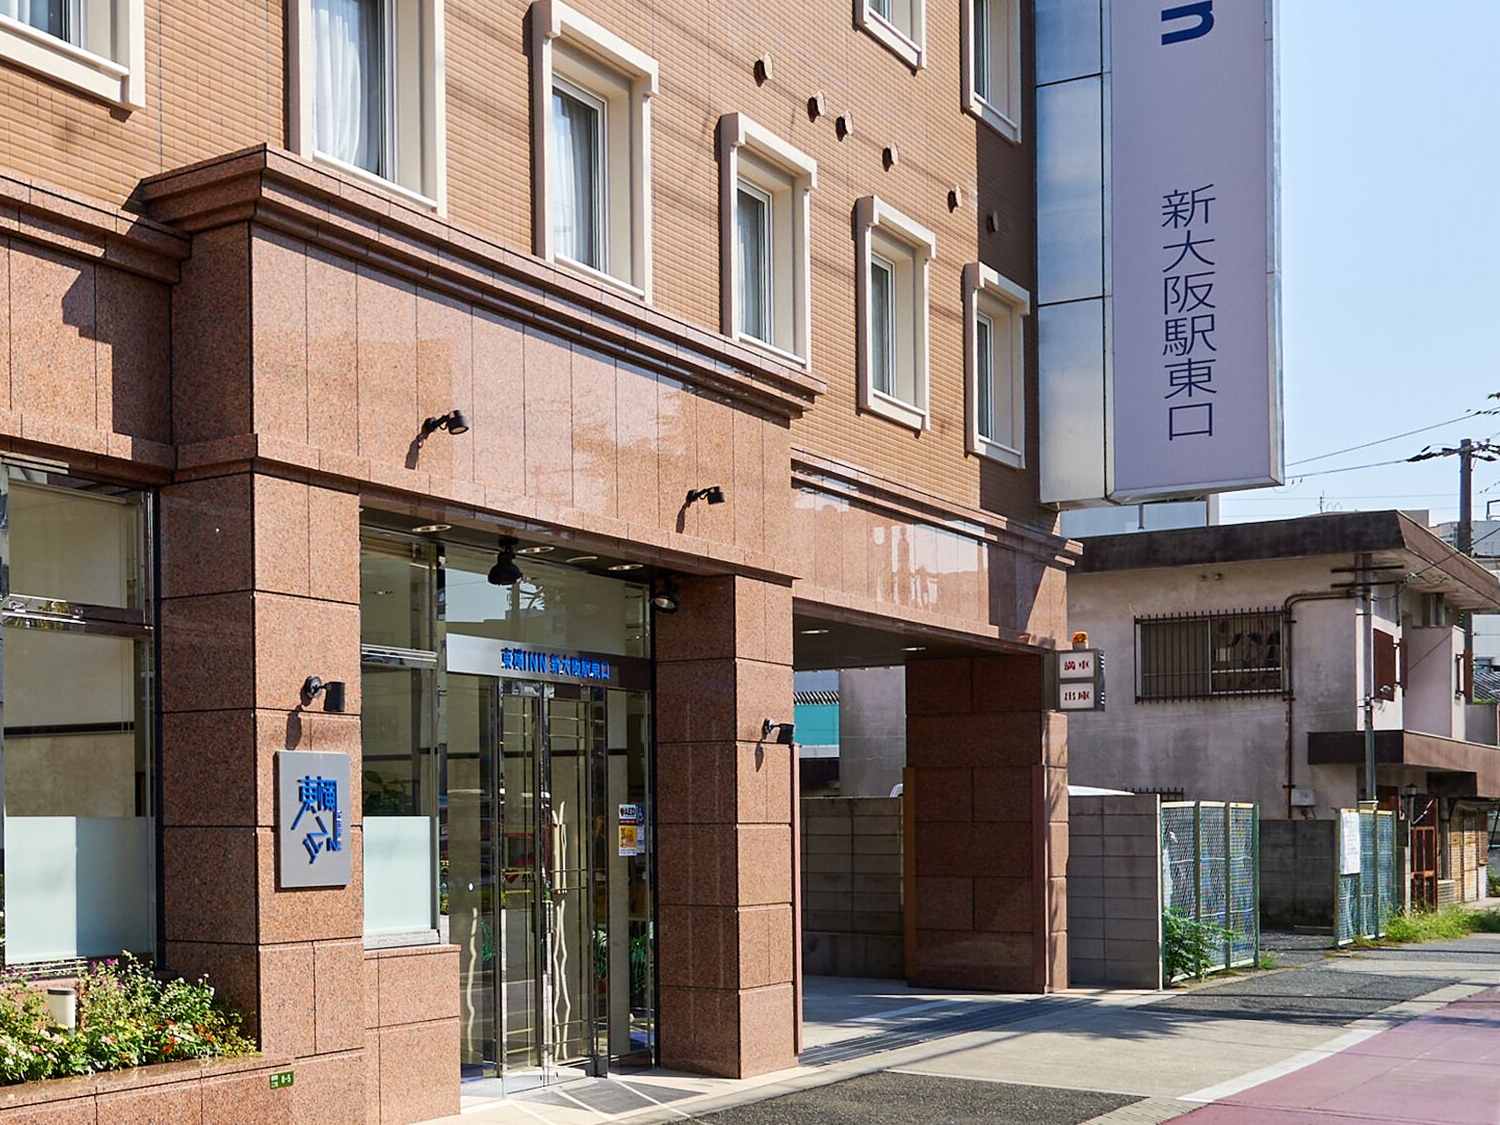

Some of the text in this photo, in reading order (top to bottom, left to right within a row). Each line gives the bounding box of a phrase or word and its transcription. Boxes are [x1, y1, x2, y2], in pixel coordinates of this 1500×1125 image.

[1161, 184, 1217, 441] 新大阪駅東口
